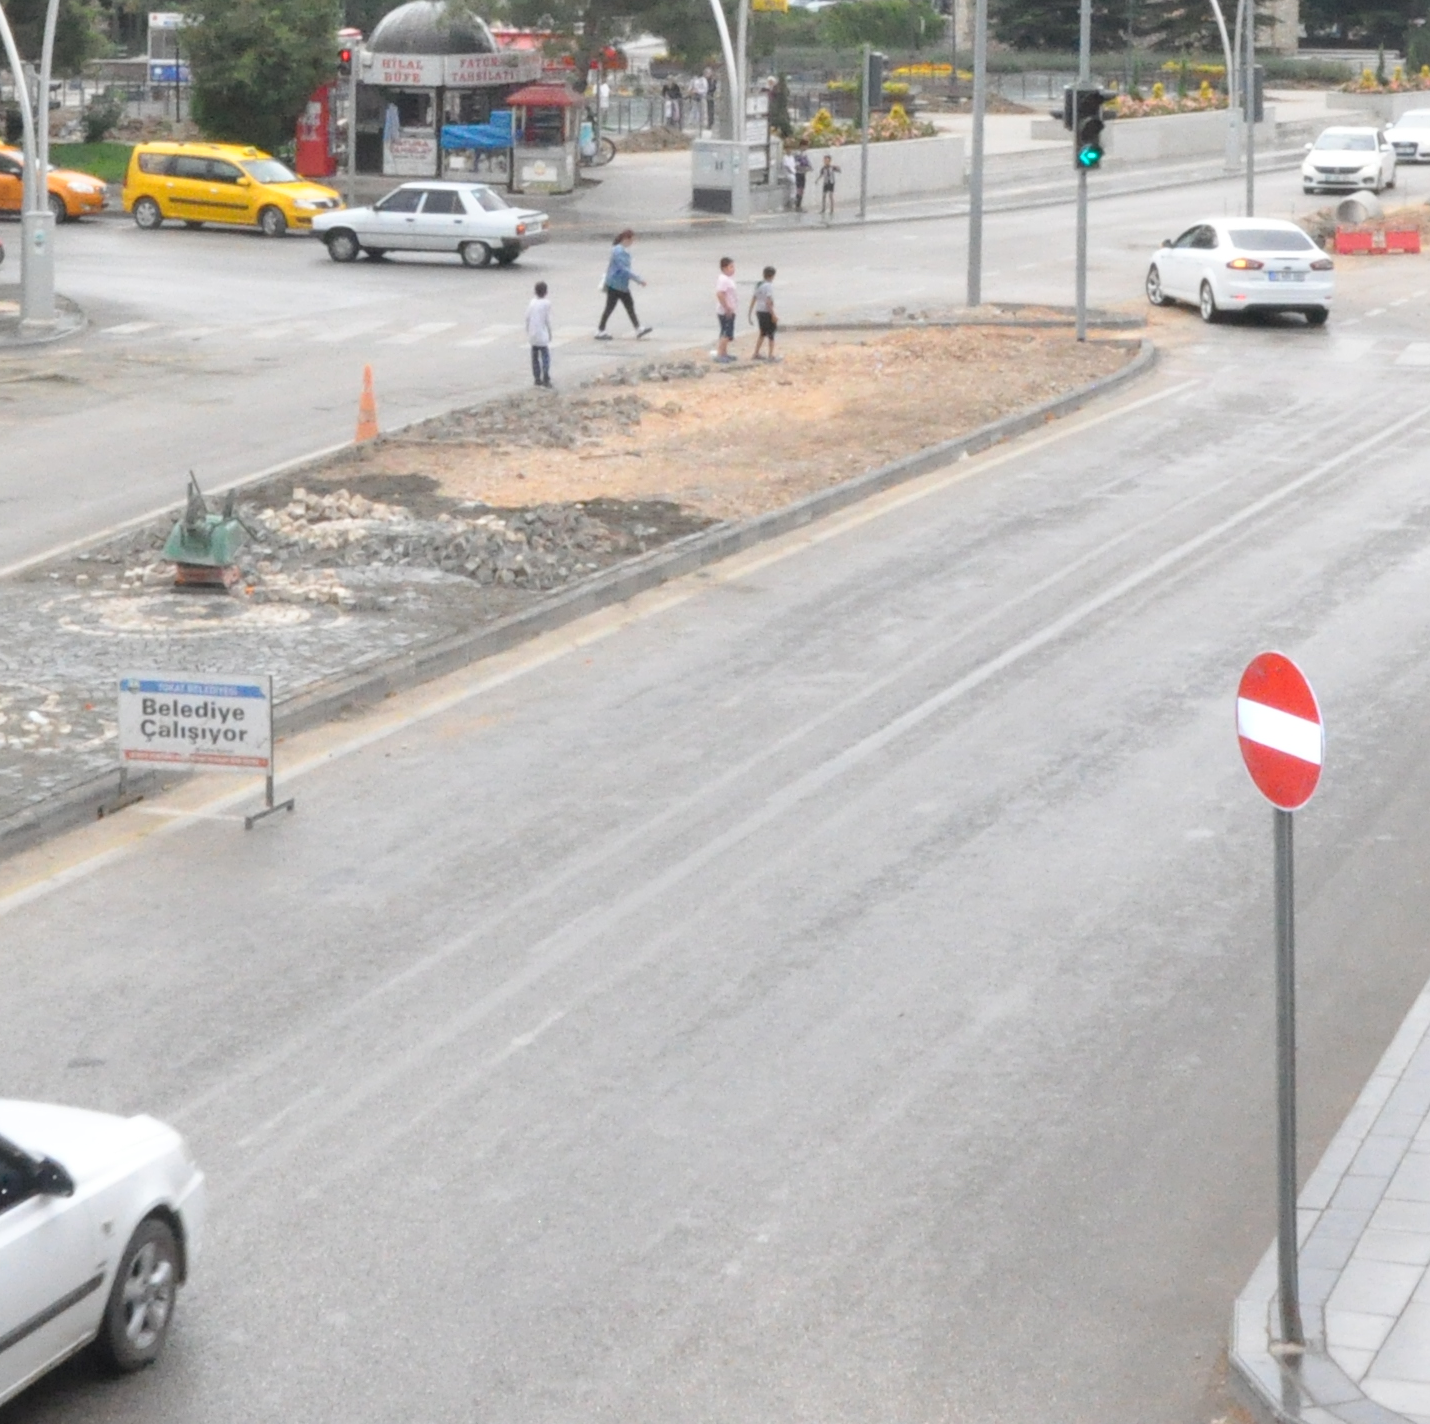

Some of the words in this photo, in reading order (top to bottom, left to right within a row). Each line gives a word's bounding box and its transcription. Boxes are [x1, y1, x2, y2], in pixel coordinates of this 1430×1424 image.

[382, 57, 424, 70] HİLAL
[459, 56, 507, 69] FATUR
[384, 71, 421, 83] BÜFE
[141, 698, 245, 724] Belediye
[140, 719, 249, 745] Çalışıyor
